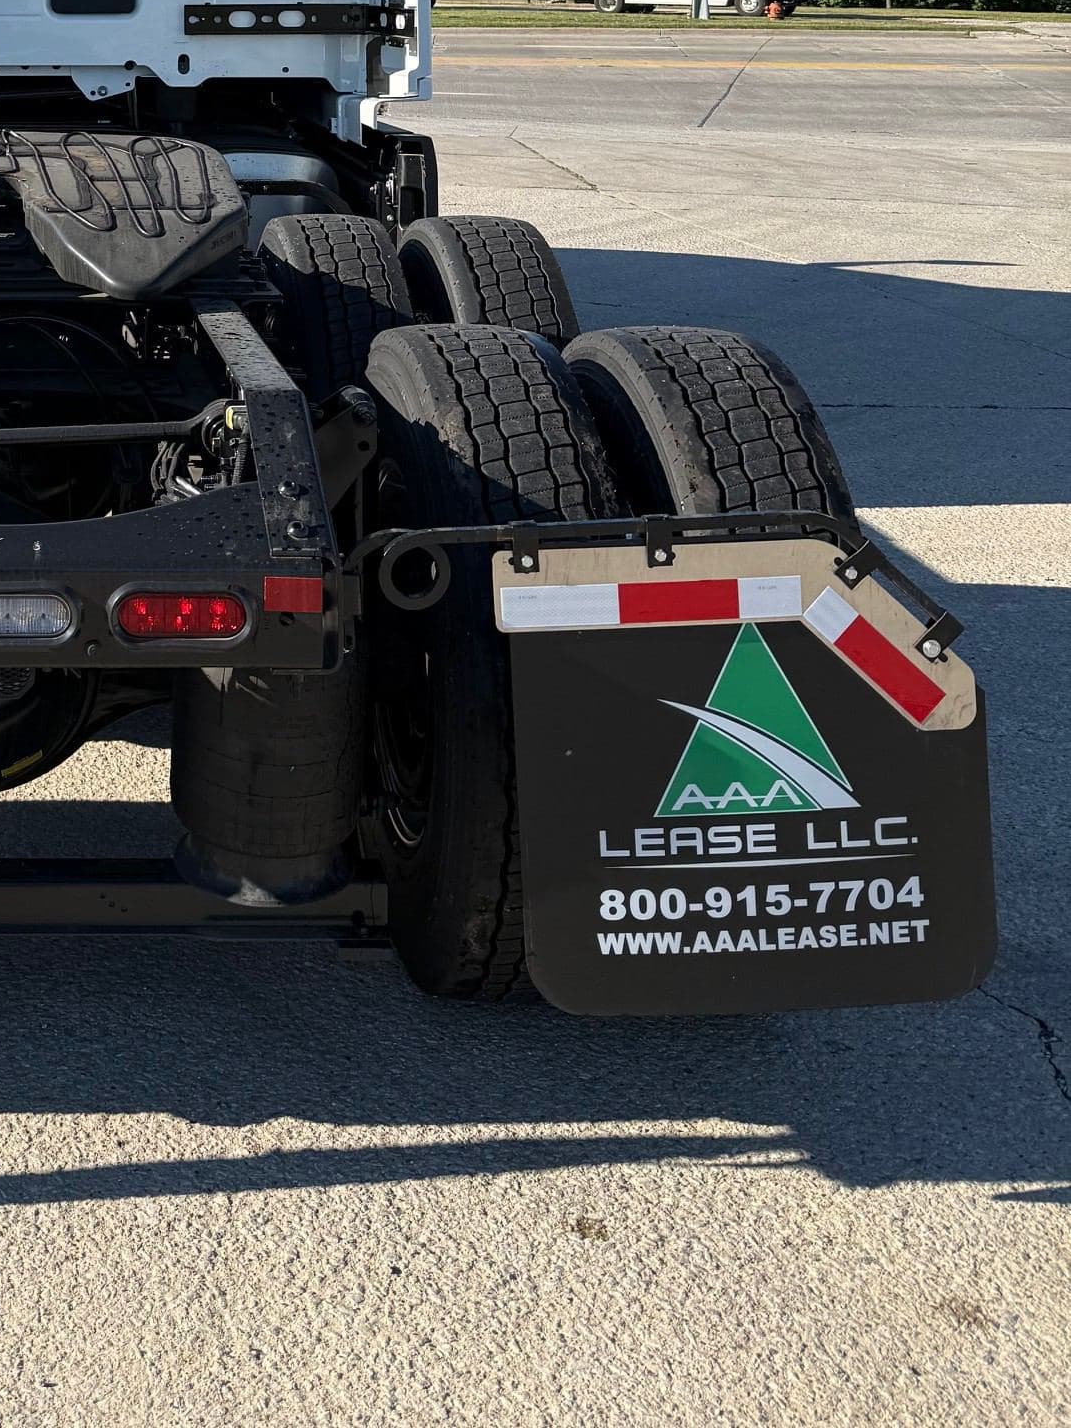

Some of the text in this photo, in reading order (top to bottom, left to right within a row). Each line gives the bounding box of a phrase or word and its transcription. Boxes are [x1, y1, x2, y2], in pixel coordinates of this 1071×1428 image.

[671, 779, 803, 811] AAA
[599, 816, 918, 857] LEASE LLC.
[599, 875, 925, 921] 800-915-7704
[596, 919, 930, 955] WWW.AAALEASE.NET
